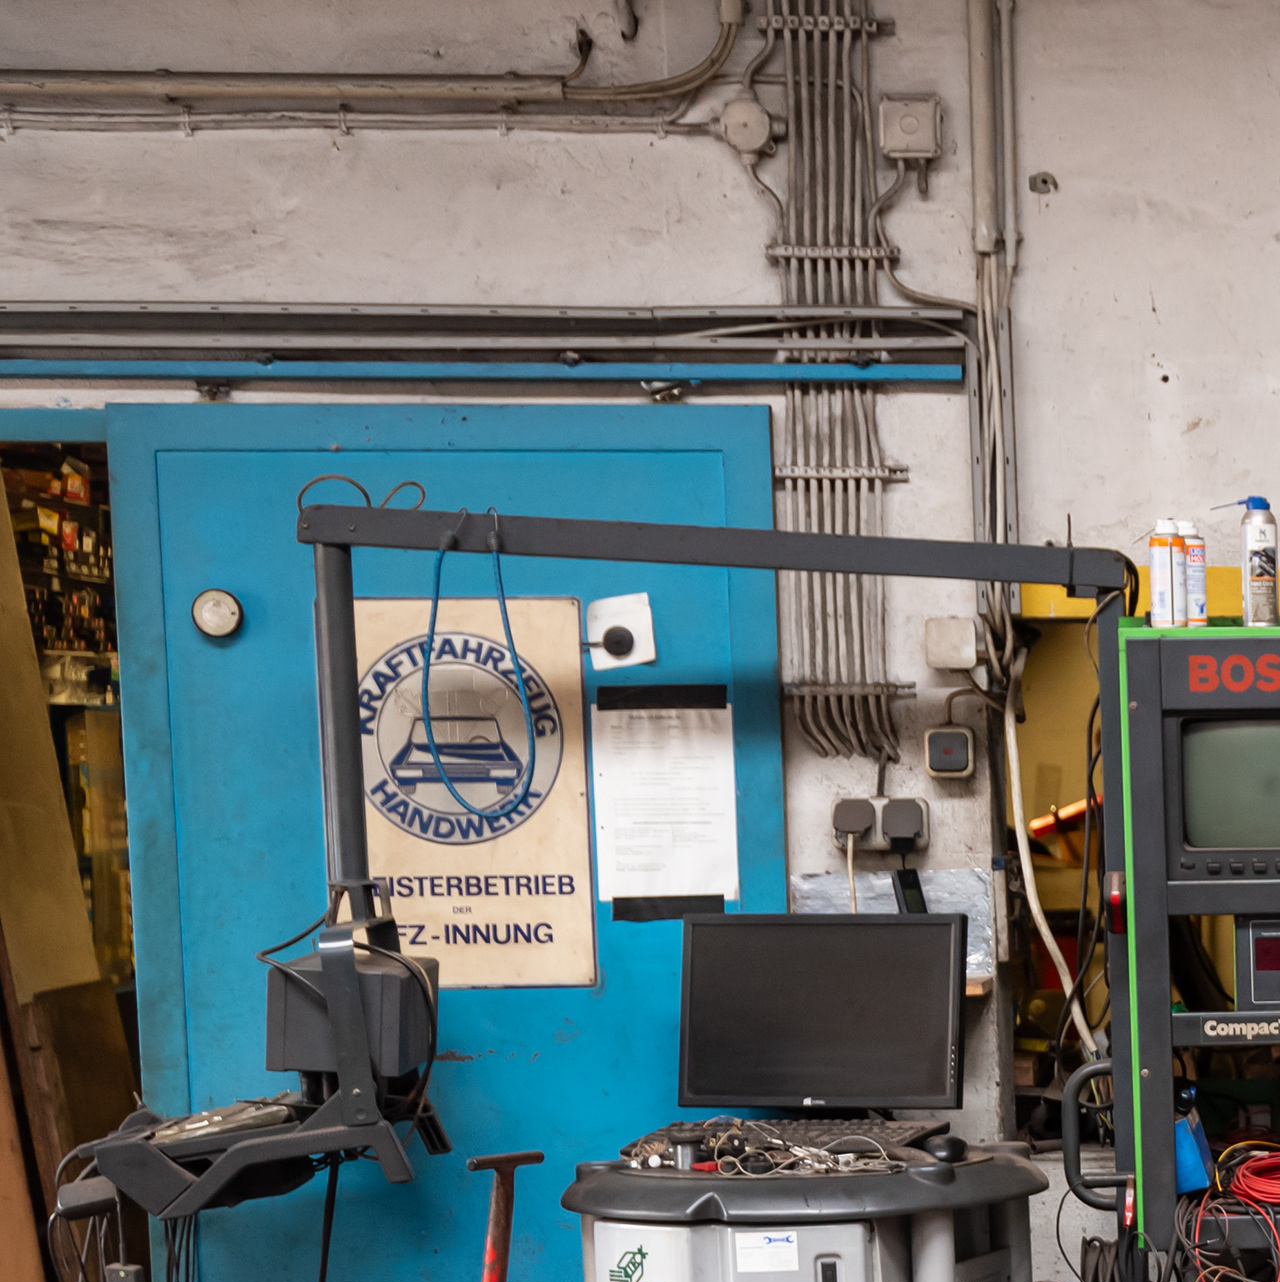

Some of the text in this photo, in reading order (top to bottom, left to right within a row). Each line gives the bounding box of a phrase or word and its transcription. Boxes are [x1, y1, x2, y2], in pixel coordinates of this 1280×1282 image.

[360, 637, 557, 738] KRAFTFAHRZEUG
[370, 778, 542, 841] HANDWERK
[370, 875, 575, 898] EISTERBETRIEB
[452, 905, 473, 914] DER
